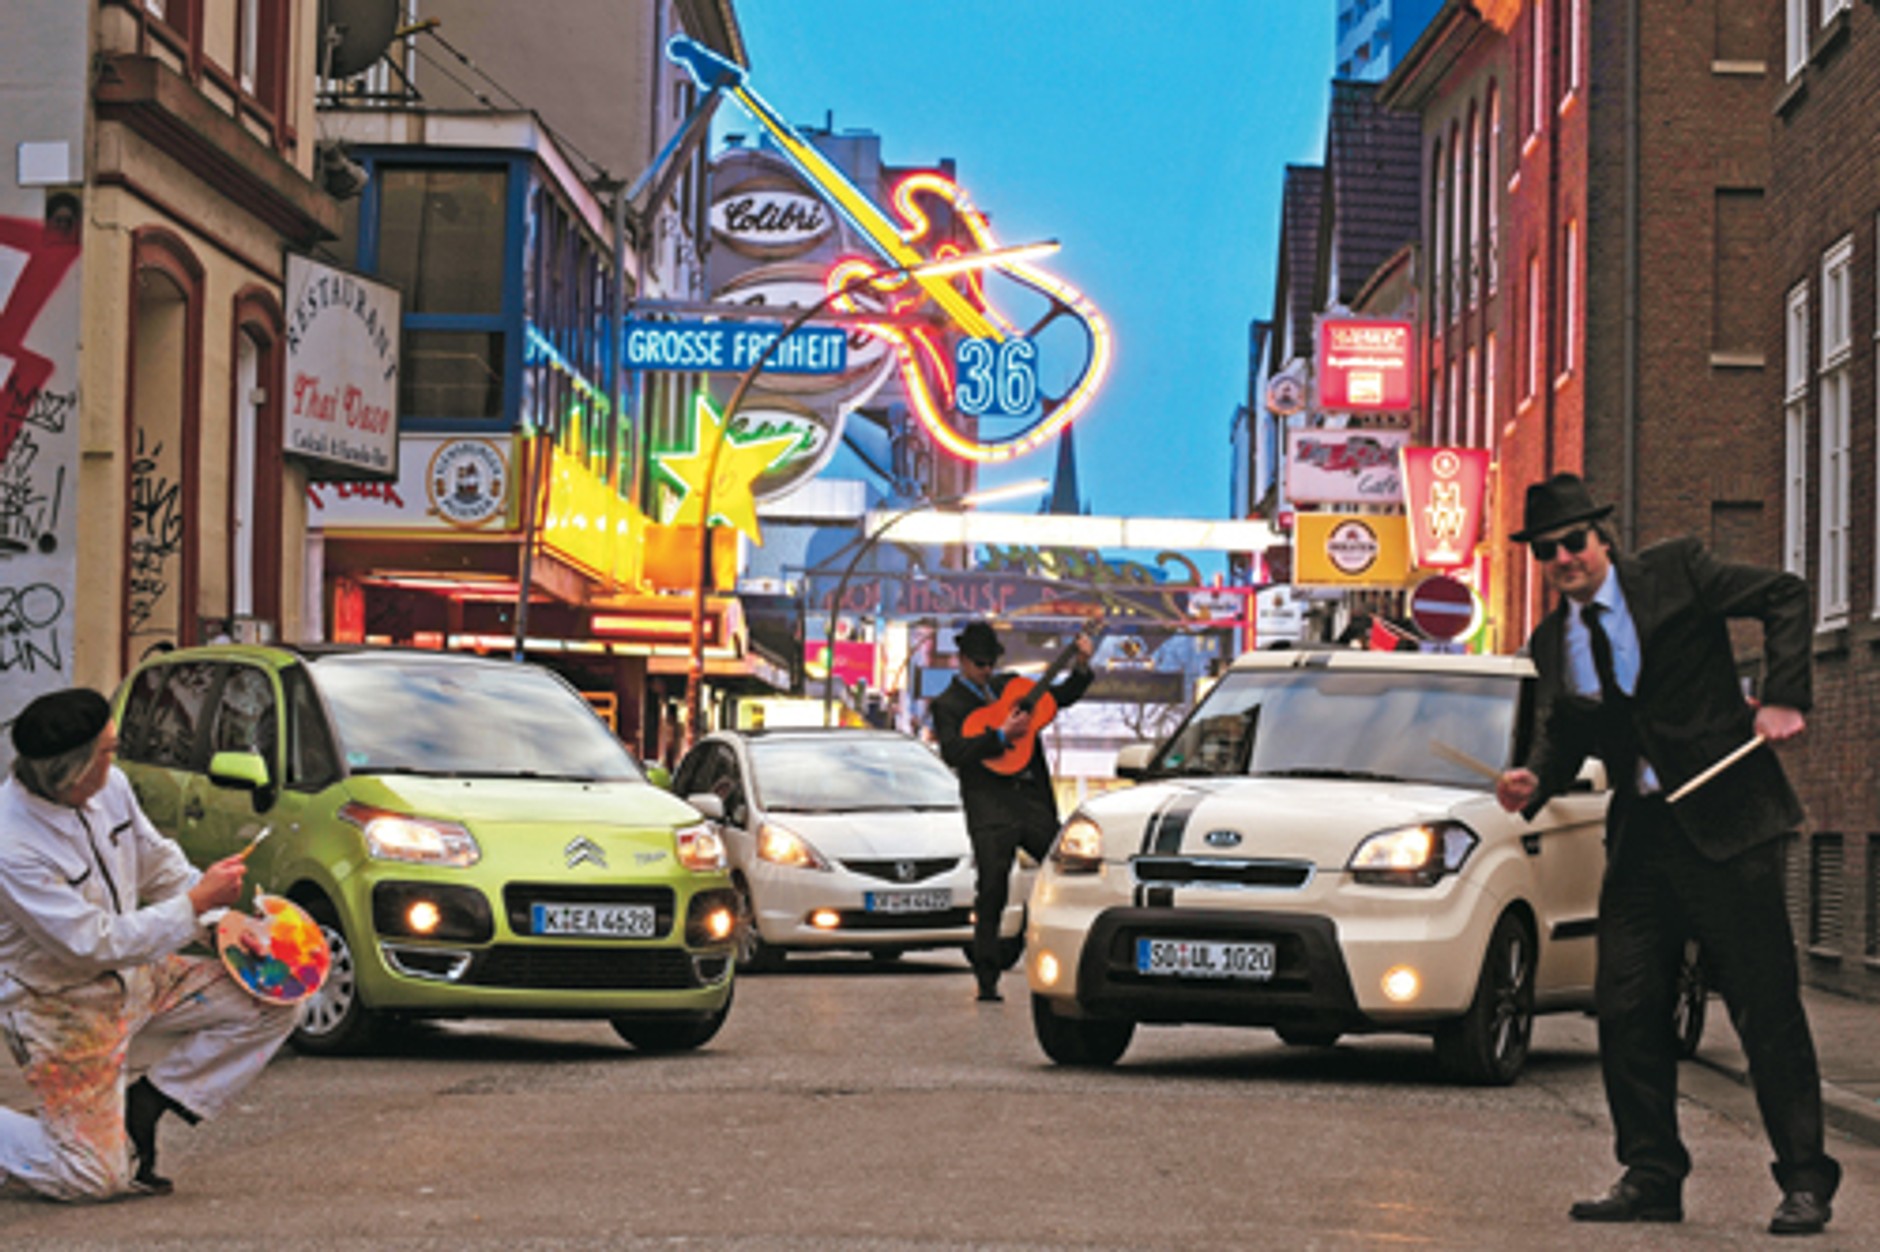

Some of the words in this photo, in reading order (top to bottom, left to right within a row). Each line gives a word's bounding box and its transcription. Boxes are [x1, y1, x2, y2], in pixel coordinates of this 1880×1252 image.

[723, 200, 823, 231] Colibri
[287, 275, 397, 382] RESTAURANT
[628, 330, 723, 366] GROSSE
[732, 333, 843, 368] FREIHEIT
[957, 338, 1034, 415] 36
